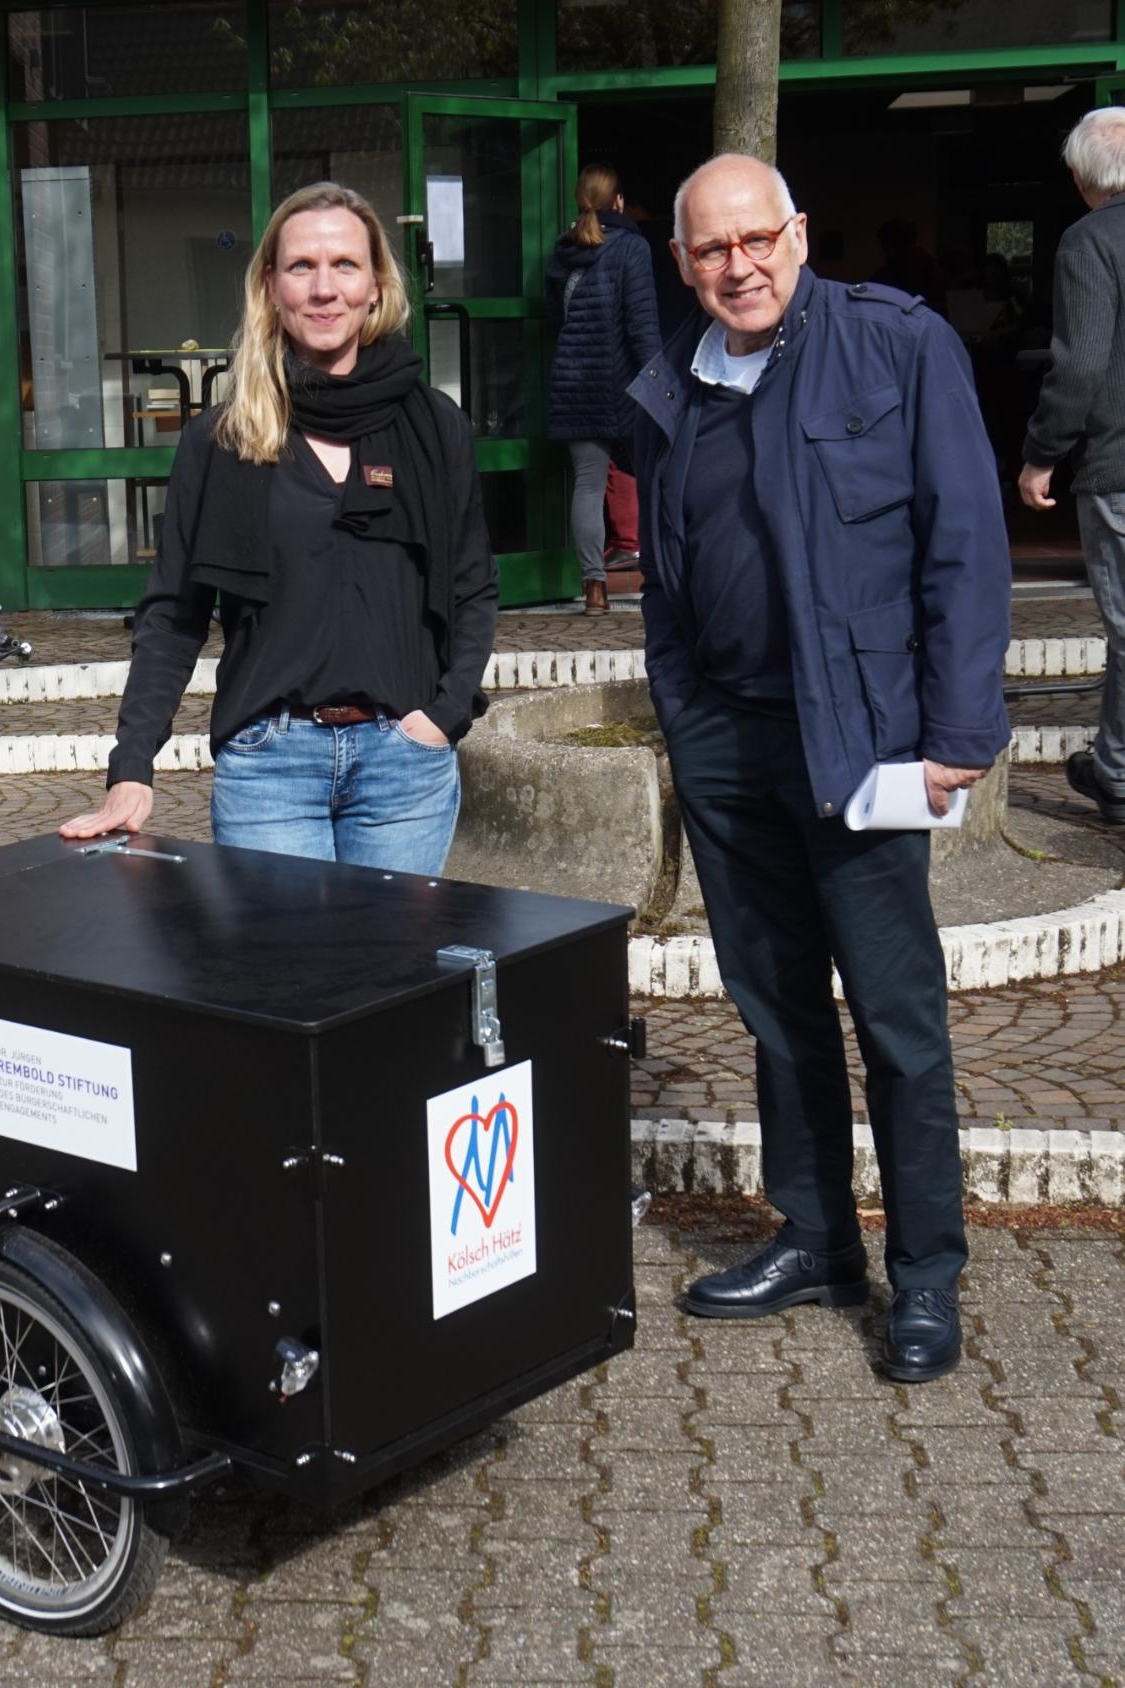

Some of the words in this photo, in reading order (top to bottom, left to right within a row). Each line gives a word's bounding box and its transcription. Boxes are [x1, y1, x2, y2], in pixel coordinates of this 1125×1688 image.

[11, 1048, 42, 1065] JÜRGEN
[15, 1079, 64, 1101] FÖRDERUNG
[58, 1074, 119, 1101] STIFTUNG
[0, 1100, 58, 1125] ENGAGEMENTS
[15, 1091, 108, 1125] BÜRGERSCHAFTLICHEN
[447, 1237, 490, 1274] Kölsch
[492, 1229, 523, 1254] Hätz
